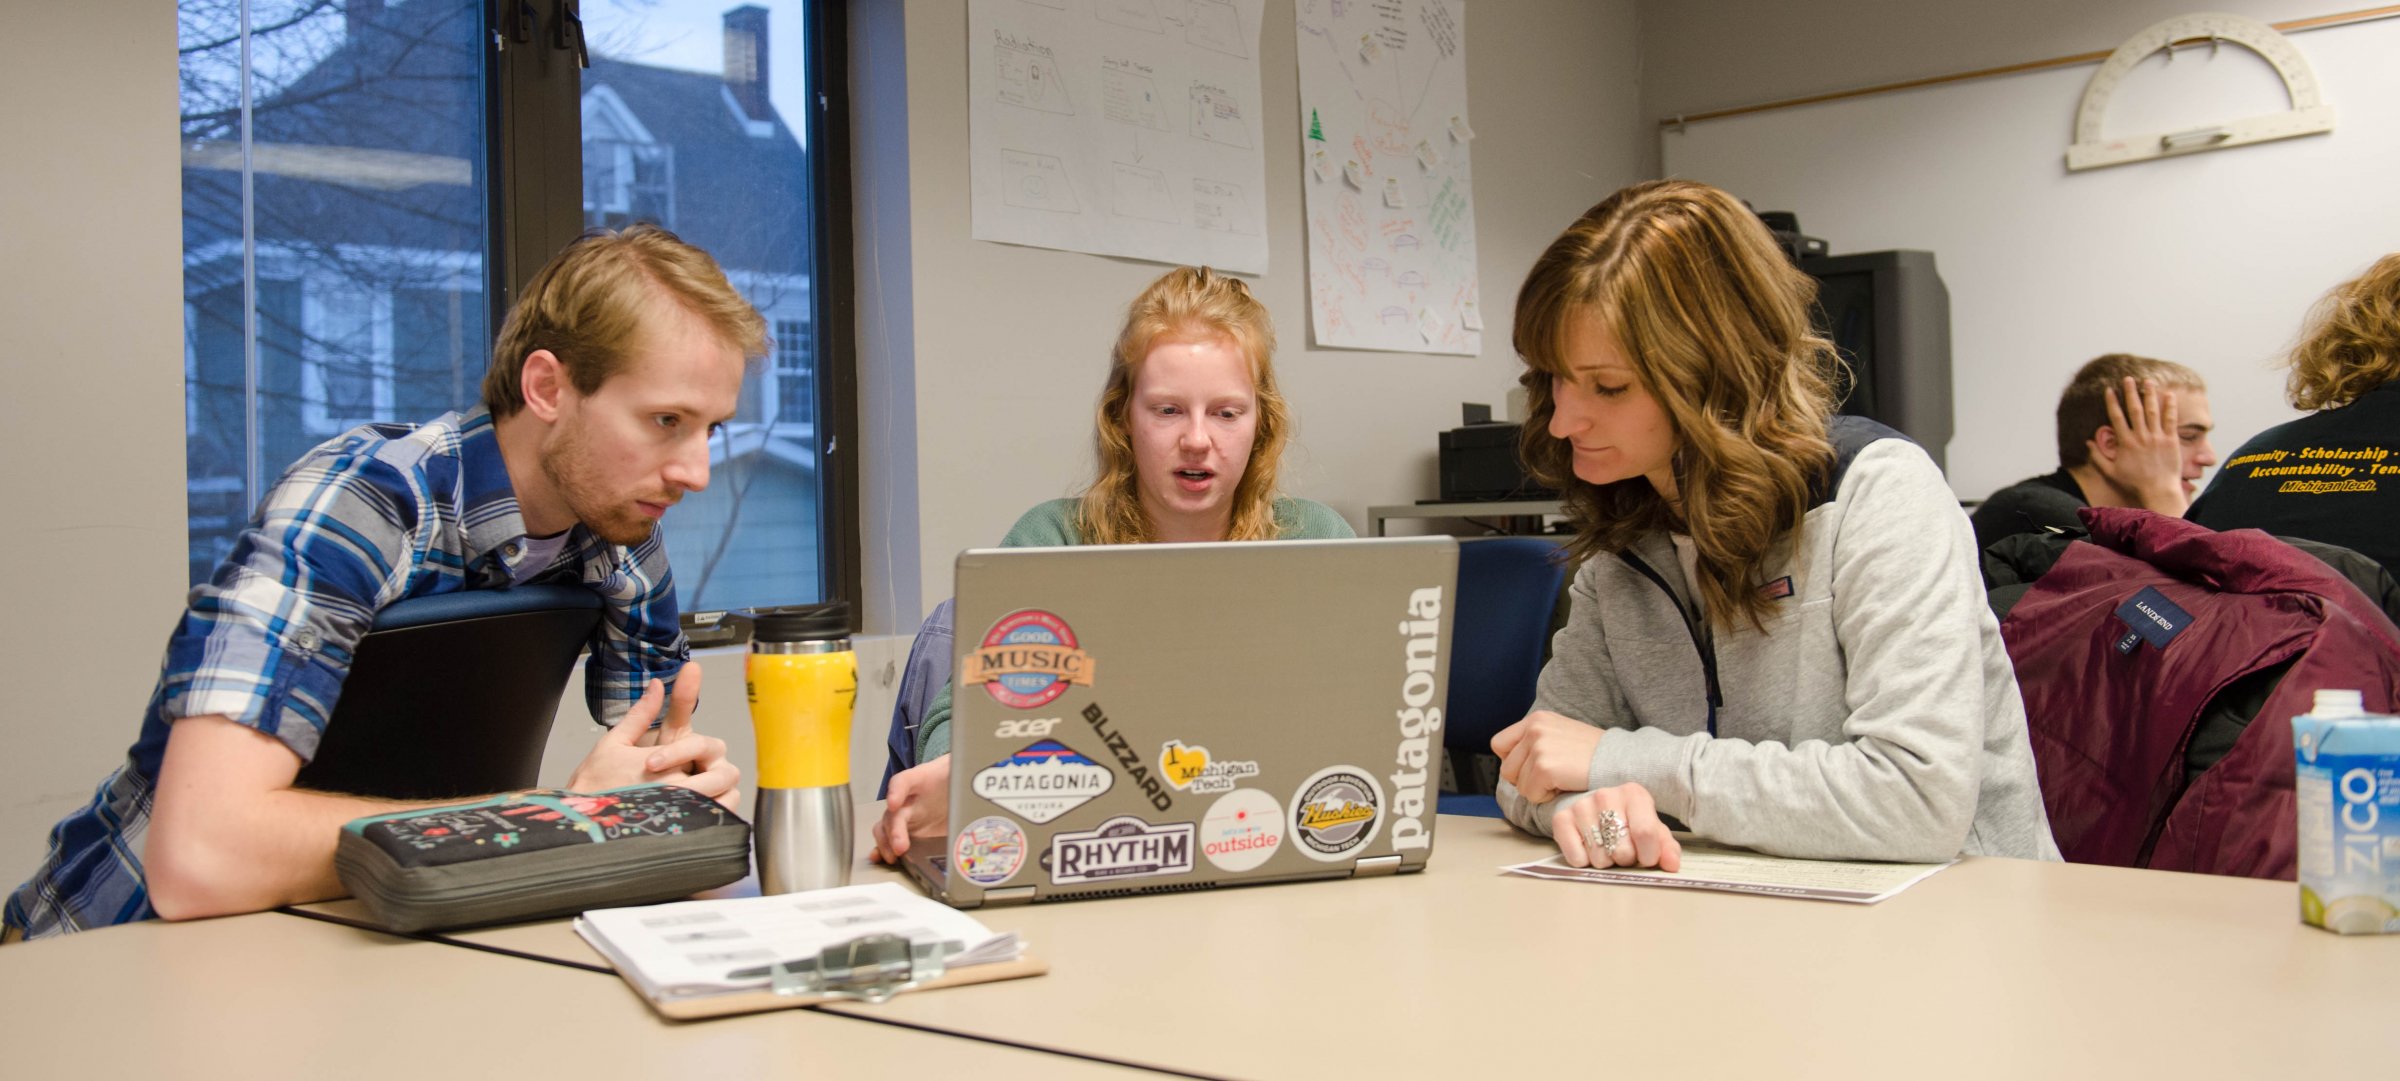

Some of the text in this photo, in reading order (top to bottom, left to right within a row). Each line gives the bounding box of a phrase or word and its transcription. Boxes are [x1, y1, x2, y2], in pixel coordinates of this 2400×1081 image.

[2299, 447, 2389, 462] Scholarship
[2249, 464, 2355, 478] Accountability
[2278, 480, 2344, 494] Michigan
[1009, 631, 1054, 643] GOOD
[982, 650, 1081, 673] MUSIC
[995, 717, 1062, 738] acer
[1391, 585, 1442, 852] patagonia
[1081, 702, 1173, 812] BLIZZARD
[1181, 762, 1256, 780] Michigan
[984, 774, 1101, 791] PATAGONIA
[1192, 779, 1231, 791] Tech
[1017, 802, 1064, 810] VENTURA
[1033, 811, 1047, 819] CA
[1302, 799, 1375, 826] Huskies
[2339, 767, 2380, 874] ZICO
[1203, 833, 1278, 855] outside
[1060, 834, 1189, 874] RHYTHM
